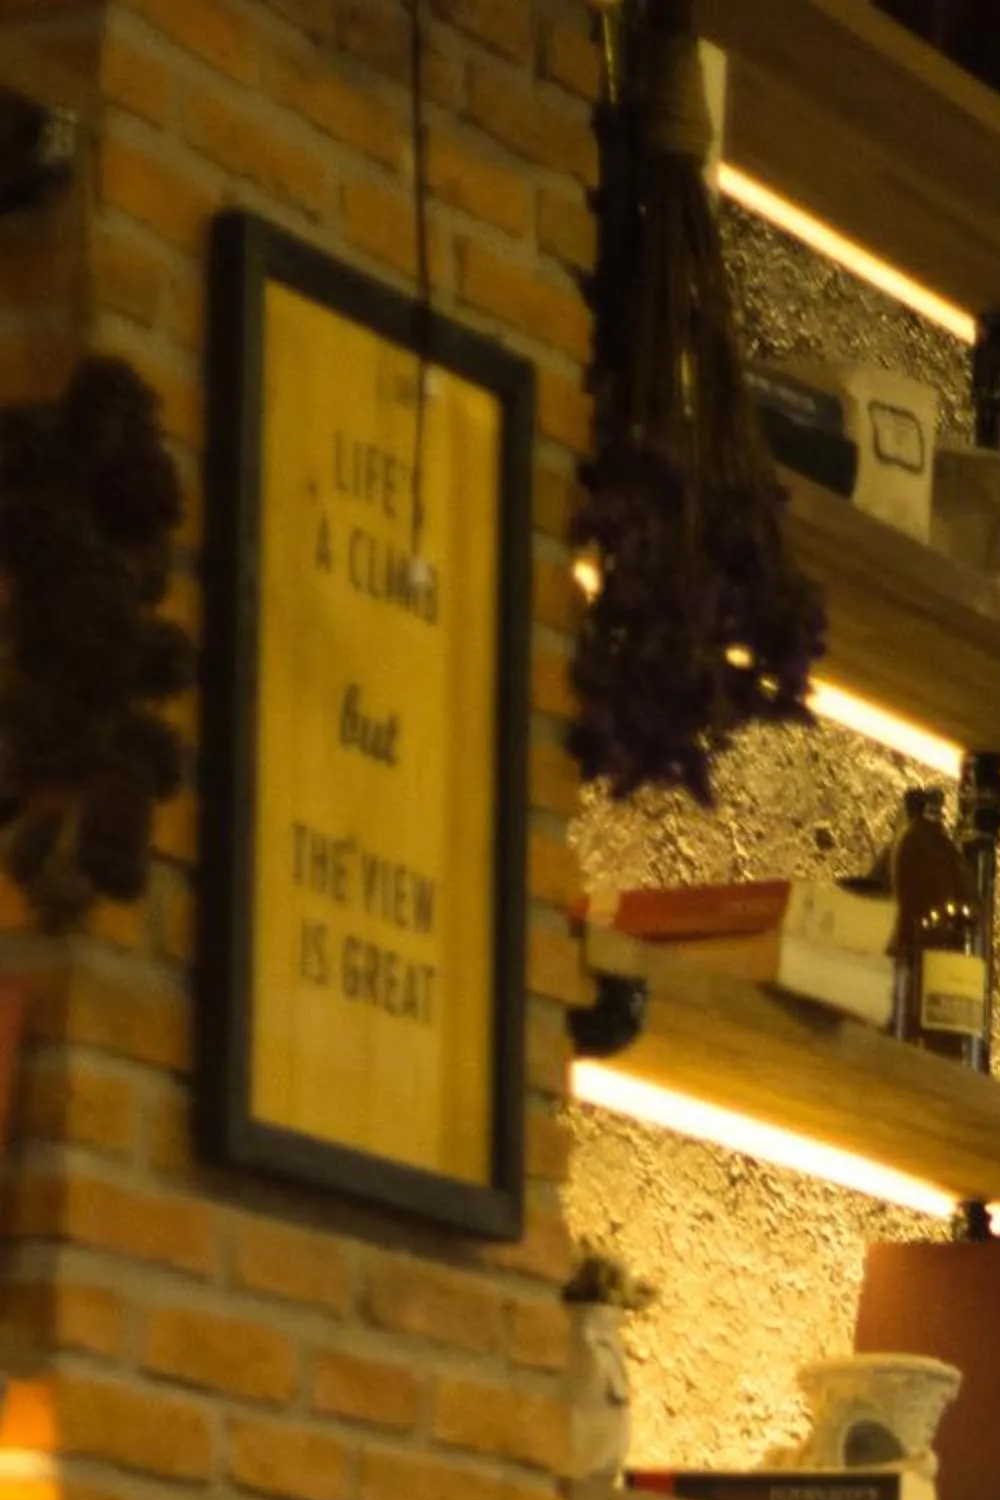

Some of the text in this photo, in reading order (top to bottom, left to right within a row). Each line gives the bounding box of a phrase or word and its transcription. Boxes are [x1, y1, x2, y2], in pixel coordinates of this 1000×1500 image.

[315, 513, 331, 573] A
[339, 683, 399, 766] but
[292, 821, 436, 934] THE VIEW
[300, 919, 435, 1026] IS GREAT
